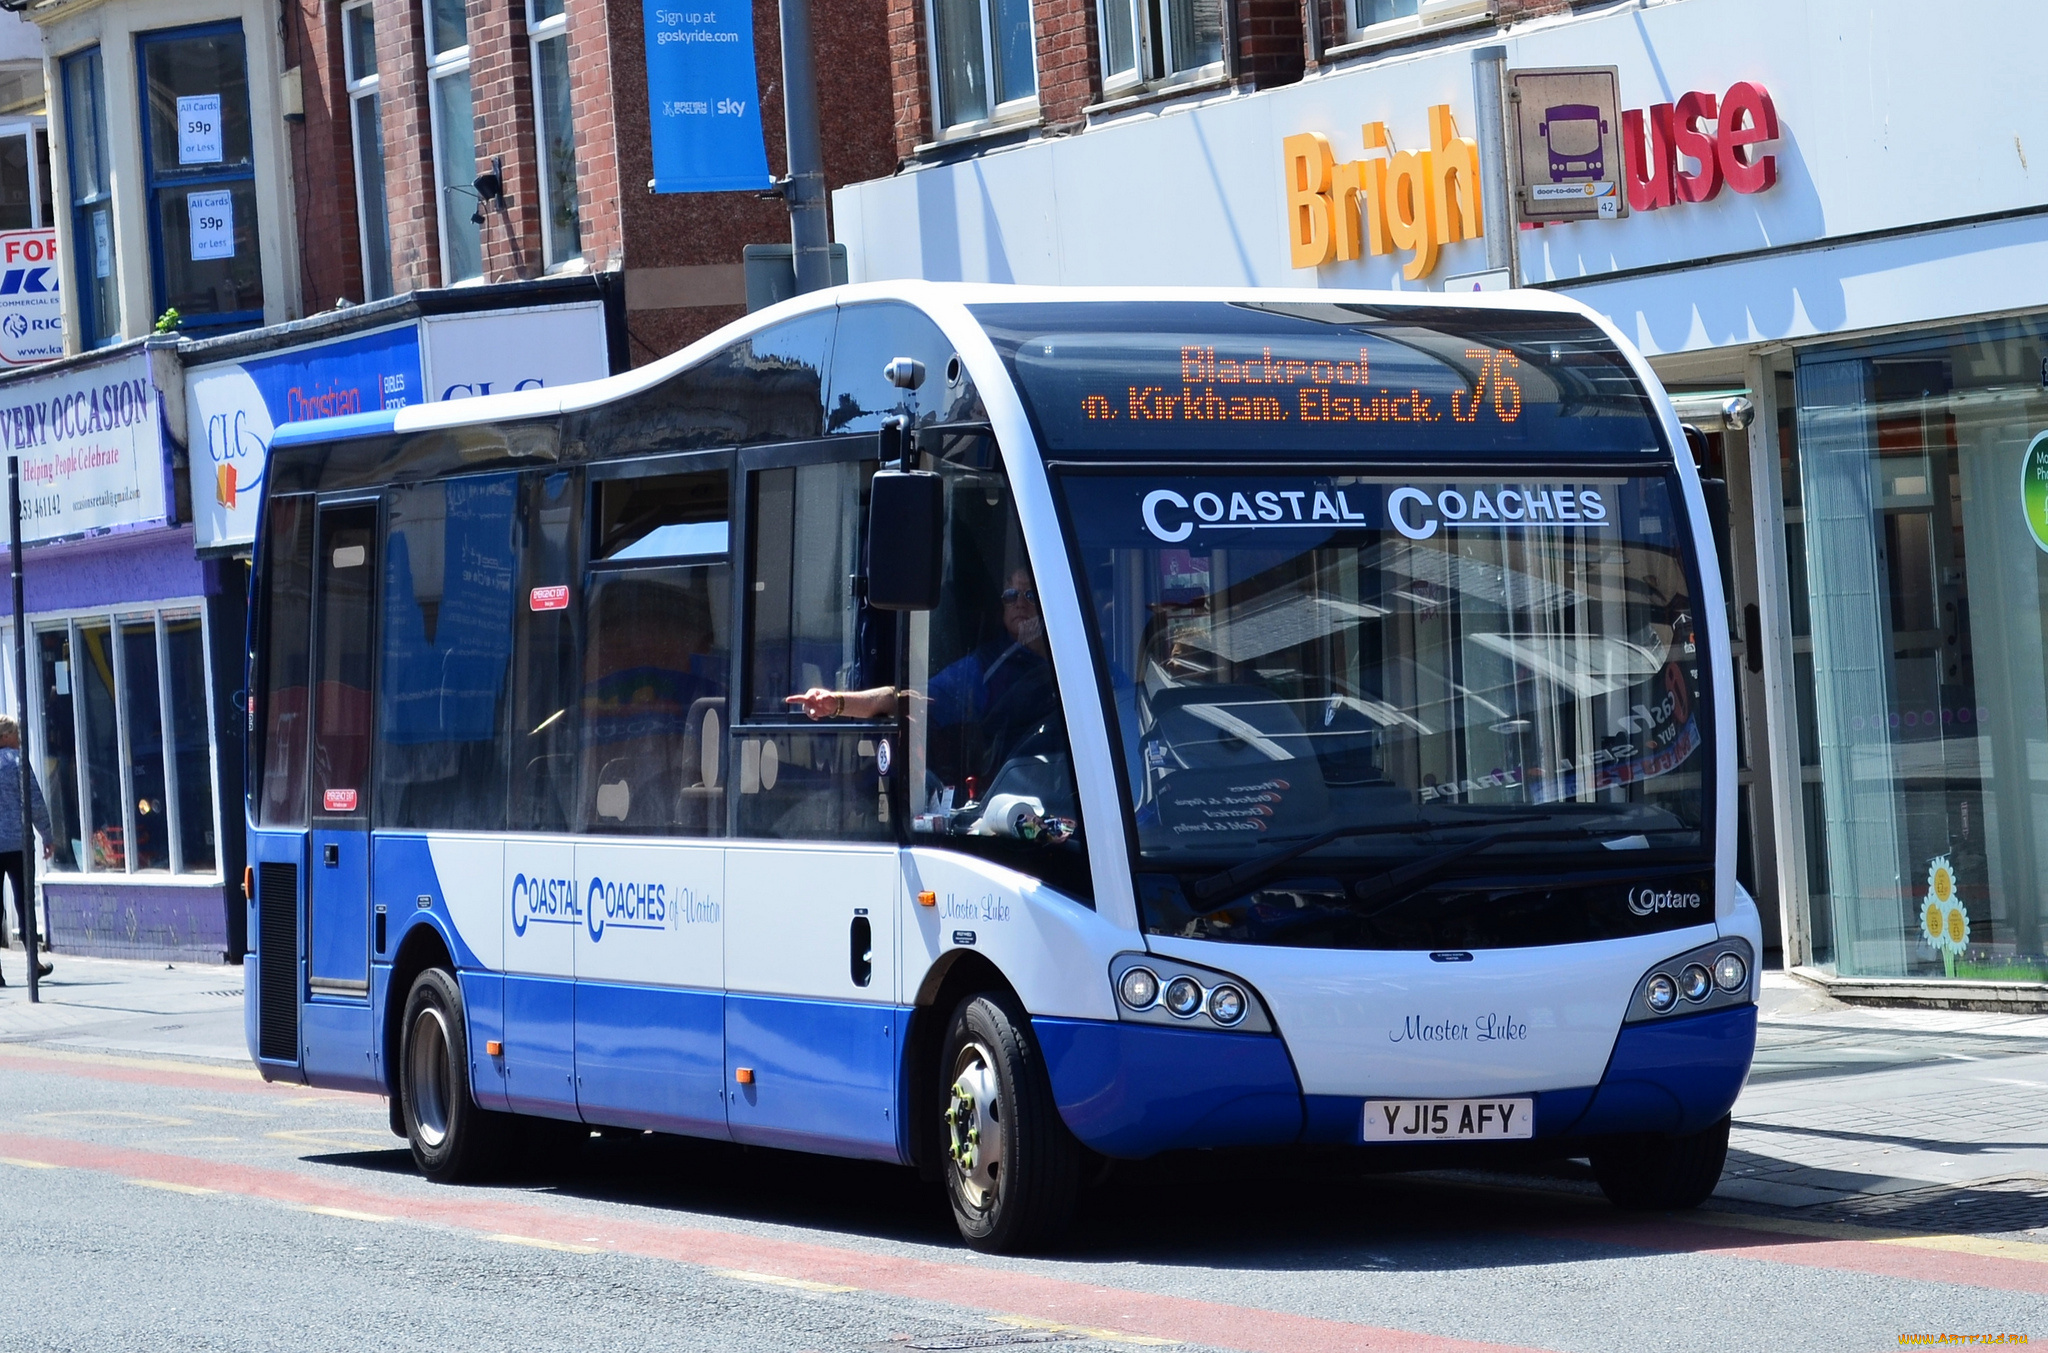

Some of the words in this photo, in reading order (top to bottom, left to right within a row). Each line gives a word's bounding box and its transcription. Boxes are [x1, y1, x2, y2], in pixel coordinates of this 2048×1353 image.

[655, 9, 683, 26] Sign
[685, 13, 701, 26] up
[703, 11, 717, 23] at
[657, 29, 738, 45] goskyride.com
[180, 103, 192, 112] All
[193, 101, 218, 111] Cards
[717, 97, 746, 117] sky
[187, 120, 212, 135] 59p
[196, 142, 215, 152] Less
[191, 198, 203, 208] All
[204, 197, 229, 207] Cards
[1536, 187, 1583, 195] door-to-door
[1601, 202, 1614, 212] 42
[199, 216, 224, 231] 59p
[198, 241, 208, 249] or
[209, 238, 227, 248] Less
[0, 267, 59, 295] K
[1181, 346, 1369, 385] Blackpool
[1465, 349, 1520, 422] 76
[52, 378, 148, 442] OCCASION
[288, 378, 361, 422] Christian
[208, 409, 248, 462] CLC
[23, 456, 53, 486] Helping
[55, 448, 77, 480] People
[78, 444, 120, 471] Celebrate
[35, 493, 61, 518] 461142
[1141, 489, 1365, 543] COASTAL
[1388, 487, 1608, 540] COACHES
[511, 873, 583, 938] COASTAL
[587, 876, 665, 943] COACHES
[668, 886, 680, 931] of
[682, 888, 721, 925] Warton
[941, 893, 979, 920] Master
[981, 893, 1010, 922] Luke
[1640, 888, 1701, 914] Optare
[1389, 1014, 1469, 1043] Master
[1475, 1012, 1527, 1042] Luke
[1383, 1104, 1449, 1135] YJ15
[1458, 1103, 1515, 1134] AFY
